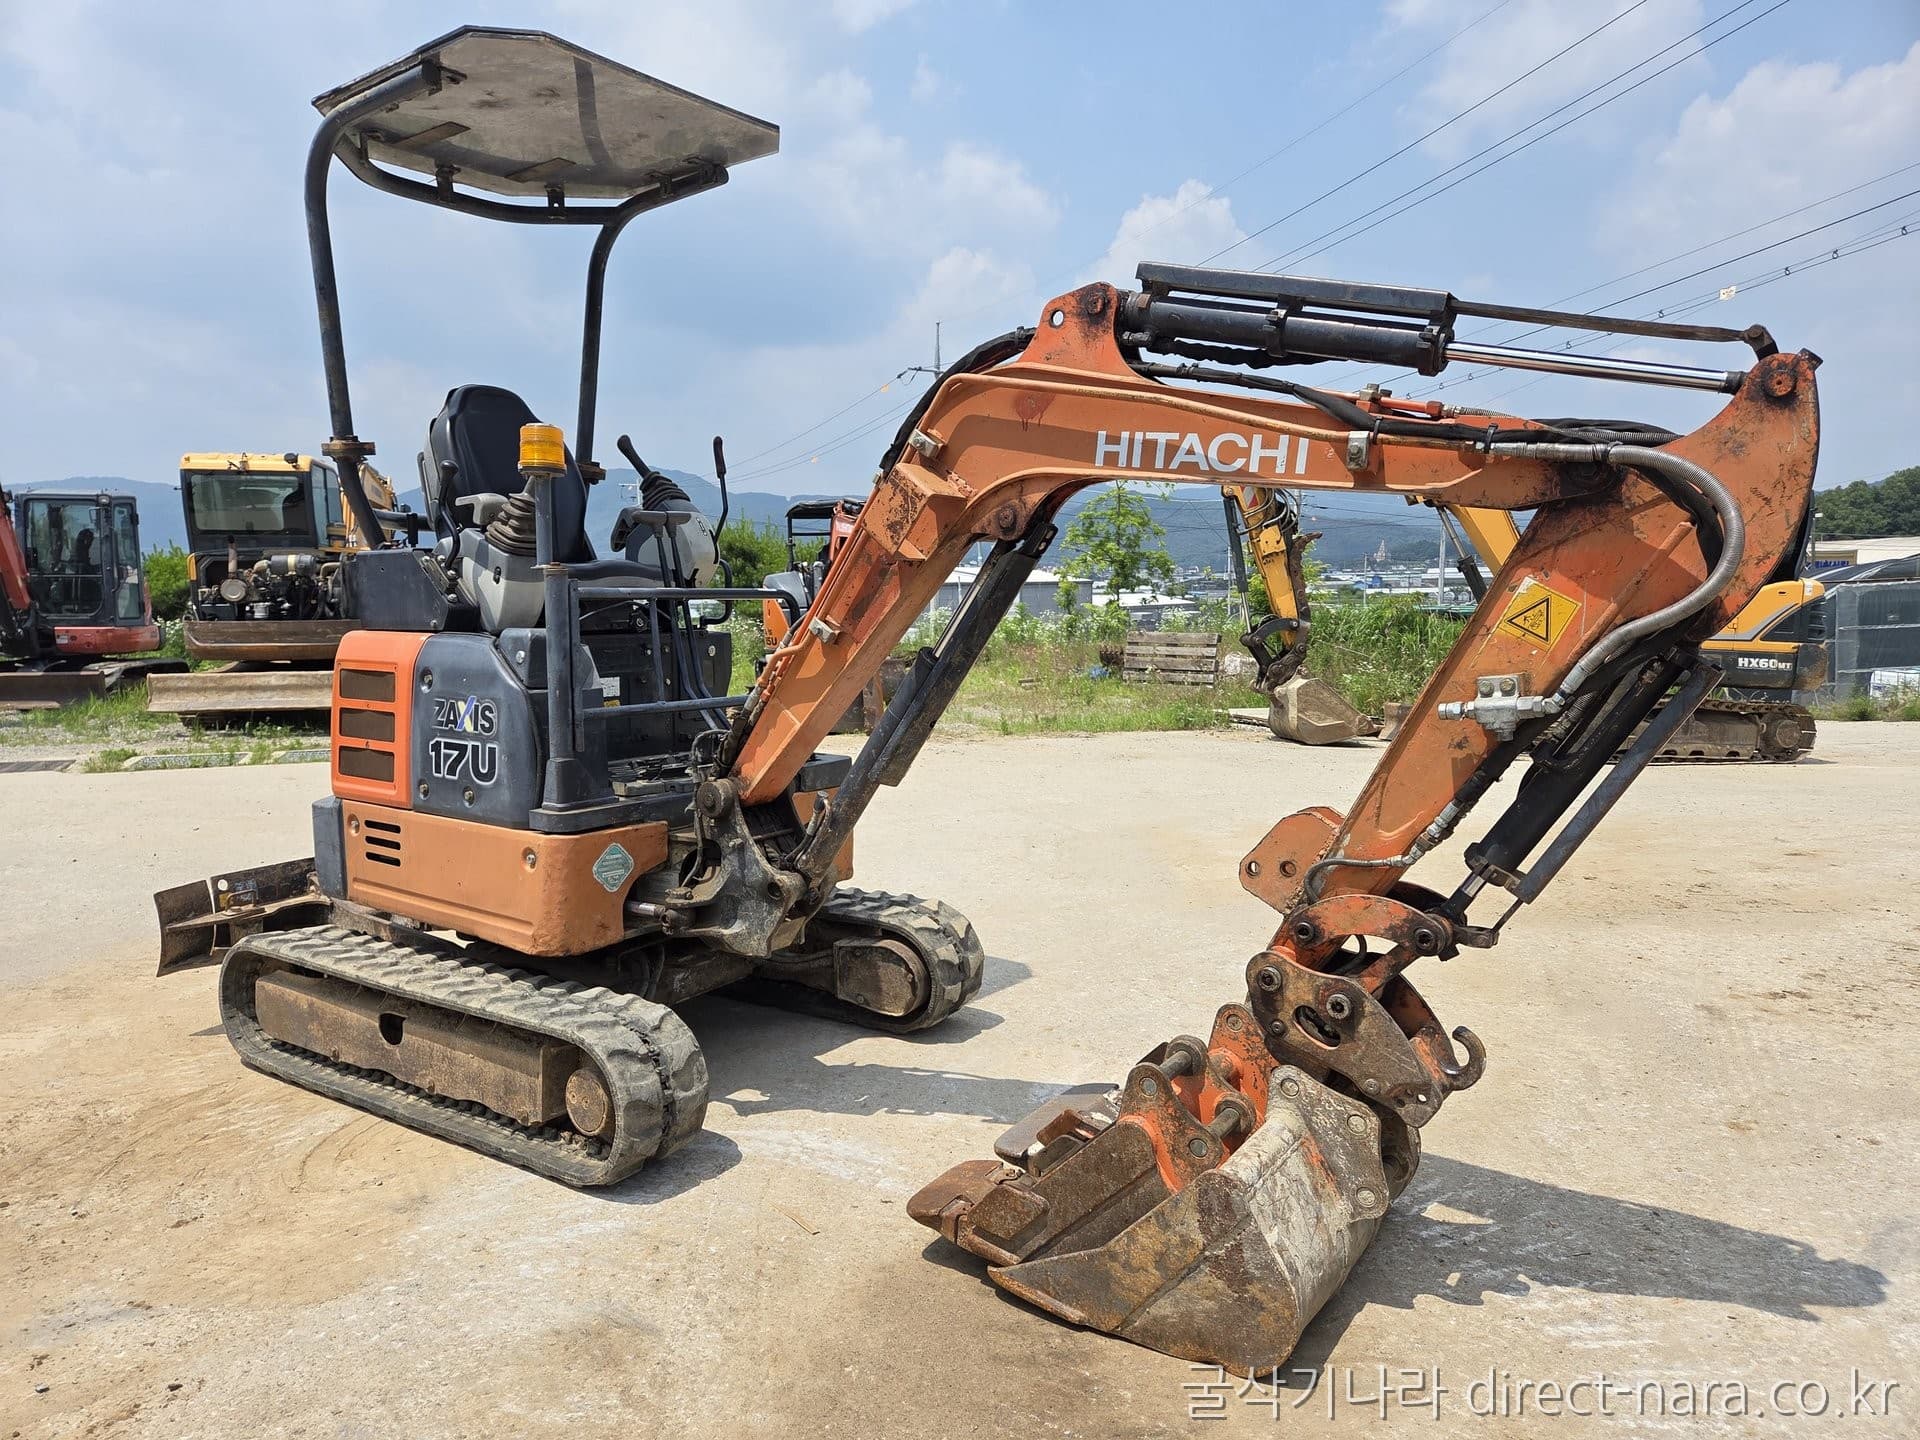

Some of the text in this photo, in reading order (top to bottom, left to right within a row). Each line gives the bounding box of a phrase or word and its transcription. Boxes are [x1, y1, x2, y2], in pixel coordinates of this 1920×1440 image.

[1095, 430, 1310, 475] HITACHI
[432, 695, 497, 736] ZAXIS
[429, 737, 498, 785] 17U
